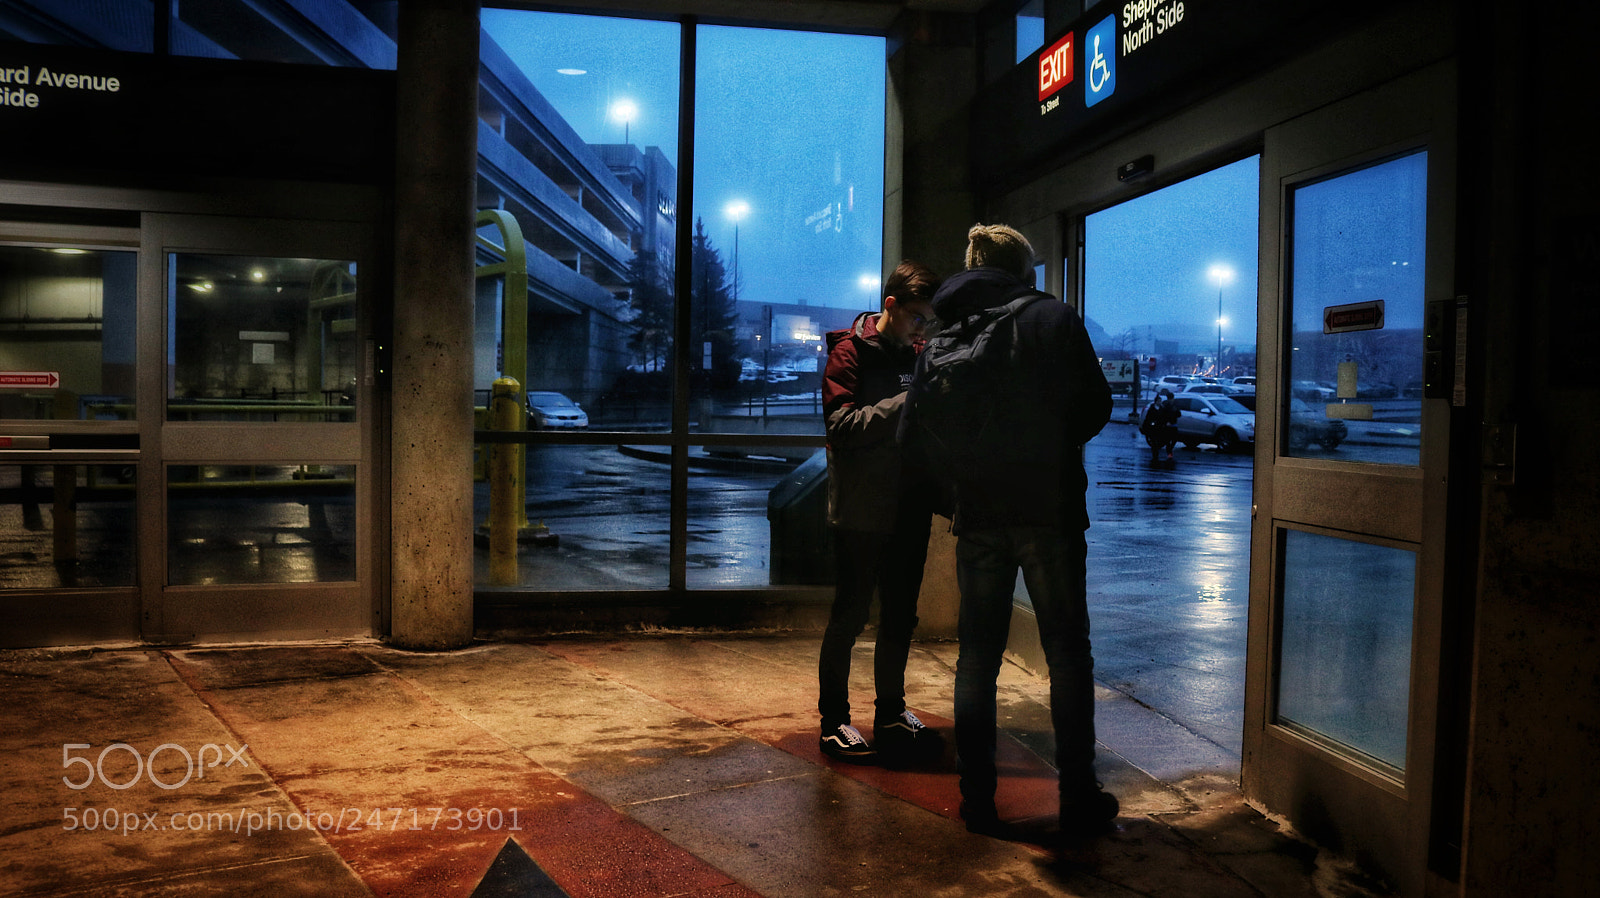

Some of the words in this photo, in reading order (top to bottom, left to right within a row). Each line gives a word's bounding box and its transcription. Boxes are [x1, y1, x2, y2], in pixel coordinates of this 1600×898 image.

[1122, 0, 1166, 28] Shepp
[1123, 19, 1154, 56] North
[1156, 1, 1185, 35] Side
[35, 67, 120, 92] Avenue
[1040, 41, 1070, 92] EXIT
[1040, 104, 1046, 115] To
[1046, 96, 1060, 111] Street
